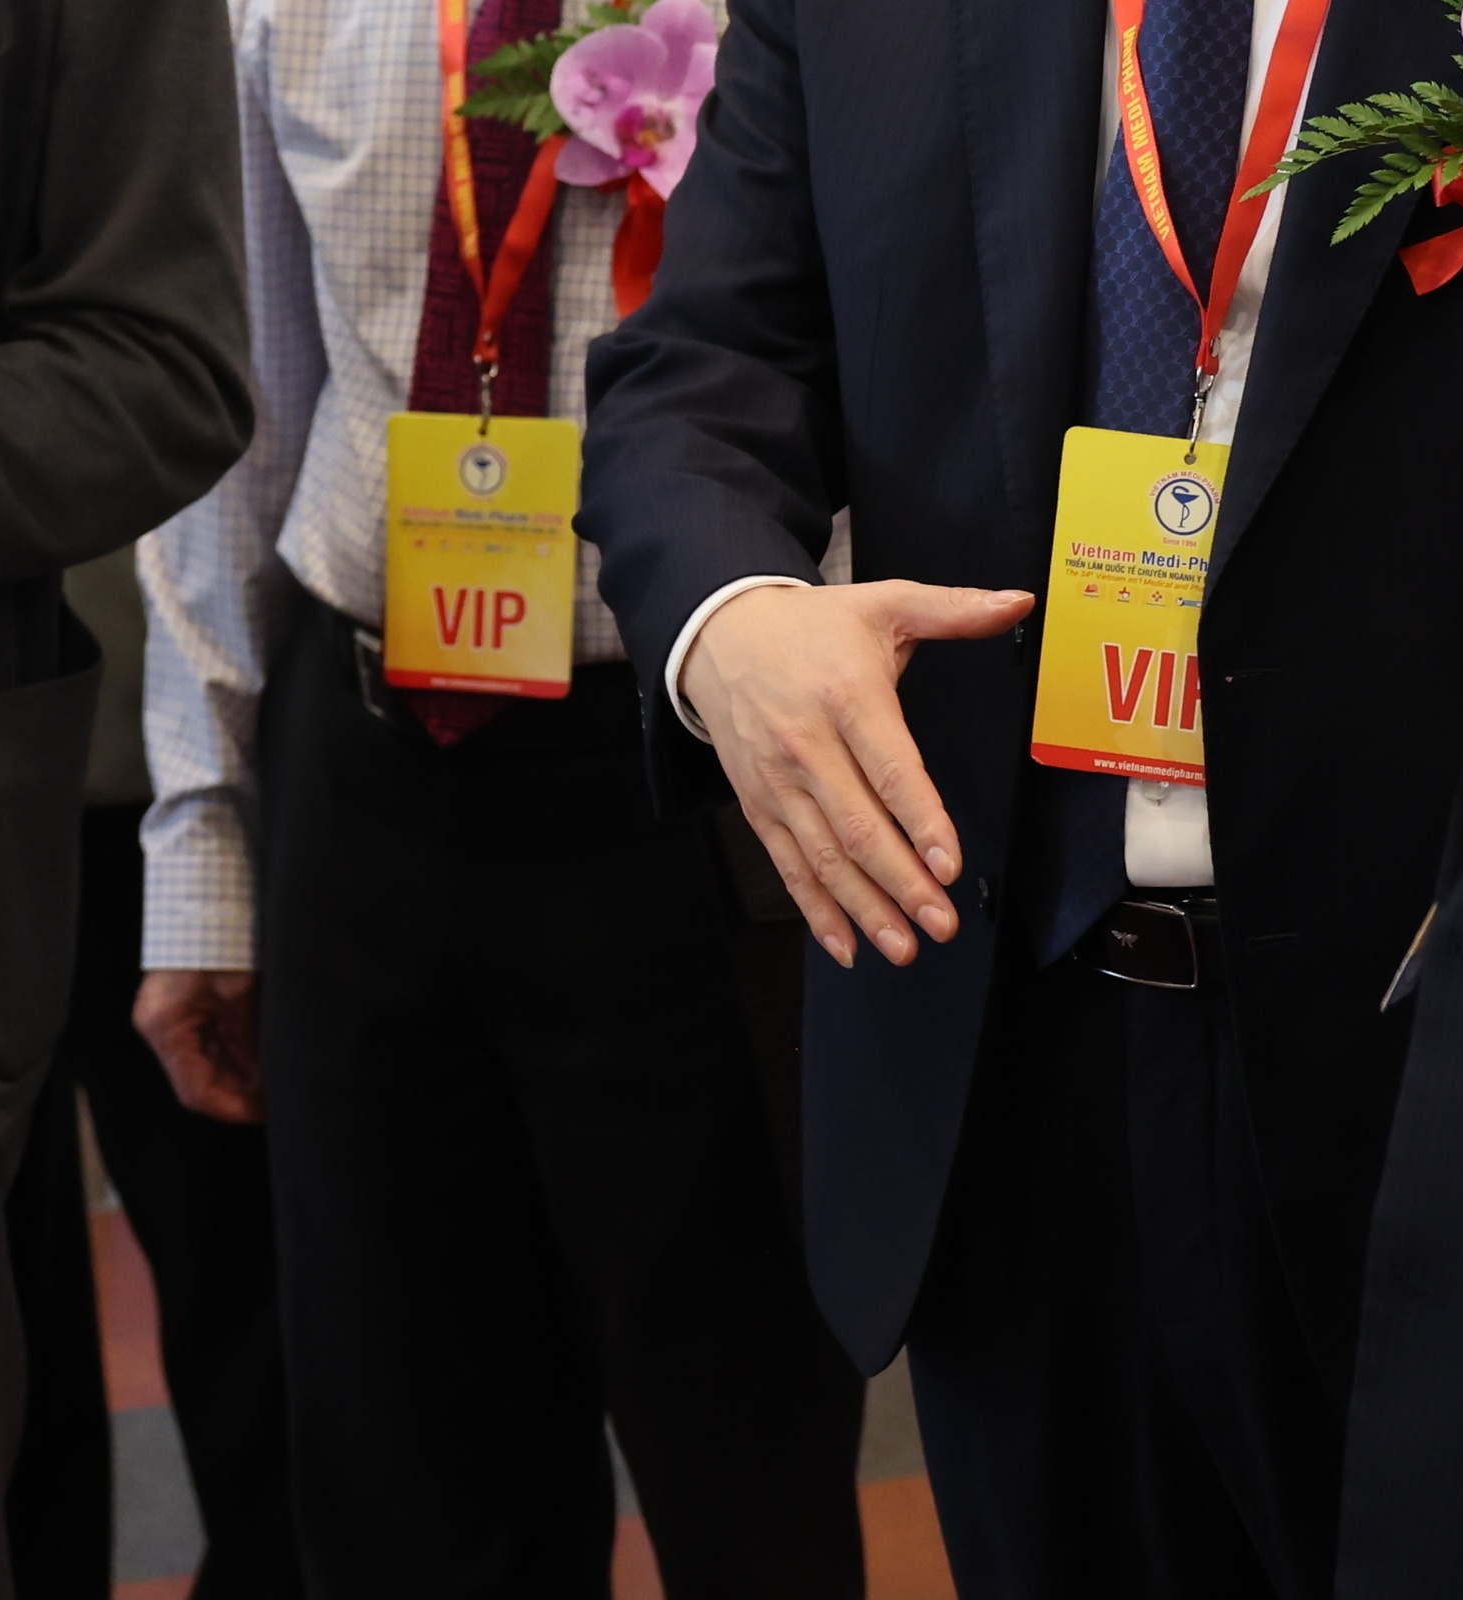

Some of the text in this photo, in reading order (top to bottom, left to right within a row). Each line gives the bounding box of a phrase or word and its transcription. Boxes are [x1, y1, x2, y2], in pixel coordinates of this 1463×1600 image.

[1120, 24, 1169, 242] VIETNAM MEDI-PHARM
[1149, 470, 1221, 505] VIETNAM MEDI-PHARM
[1071, 542, 1209, 573] Vietnam Medi-Ph
[1162, 537, 1197, 548] Since 1994
[1065, 568, 1079, 576] The
[1096, 573, 1126, 582] Vietnam
[1143, 578, 1173, 589] Medical
[433, 587, 528, 649] VIP
[1093, 758, 1206, 781] www.vietnammedipharm.
